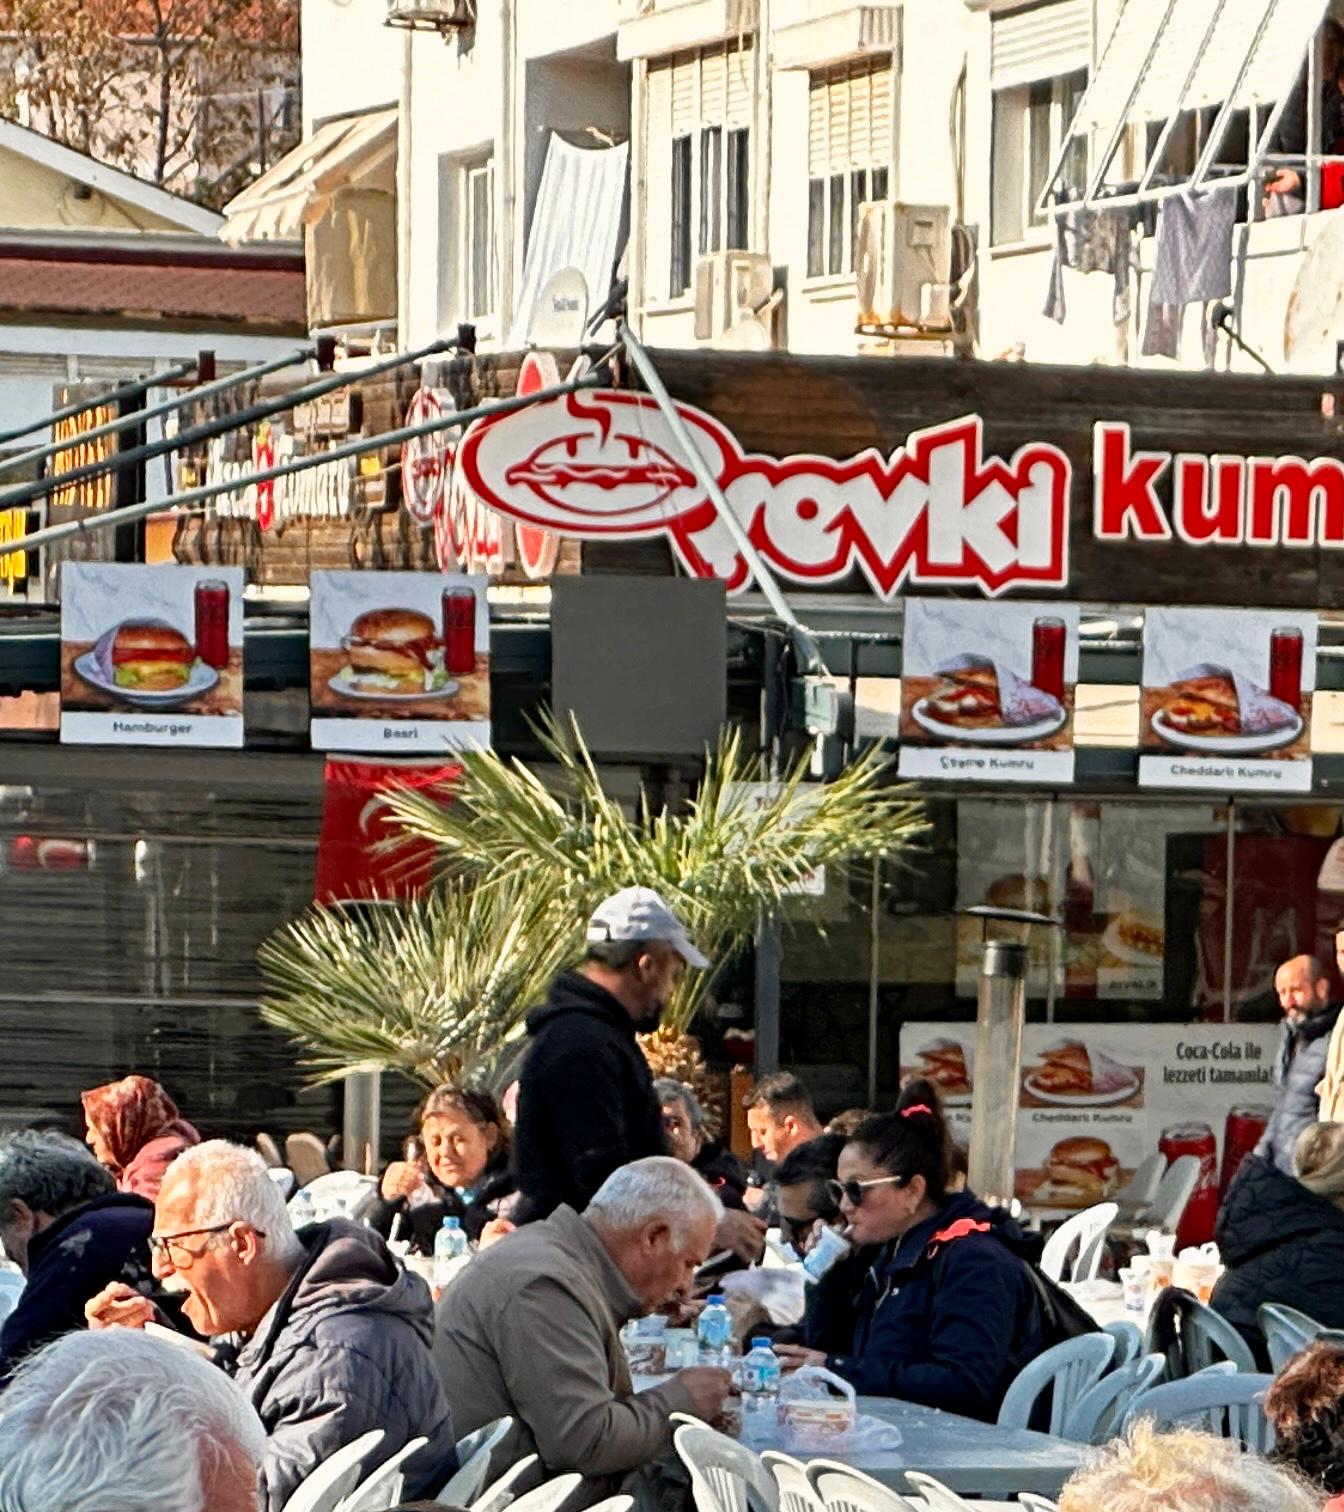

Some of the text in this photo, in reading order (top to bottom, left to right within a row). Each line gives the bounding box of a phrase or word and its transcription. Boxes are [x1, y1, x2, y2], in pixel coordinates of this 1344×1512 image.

[112, 721, 192, 736] Hamburger
[988, 756, 1035, 770] Kumru
[1237, 766, 1283, 780] Kumru
[1176, 1041, 1241, 1061] Coca-Cola
[1163, 1066, 1274, 1084] lezzeti tamamla!
